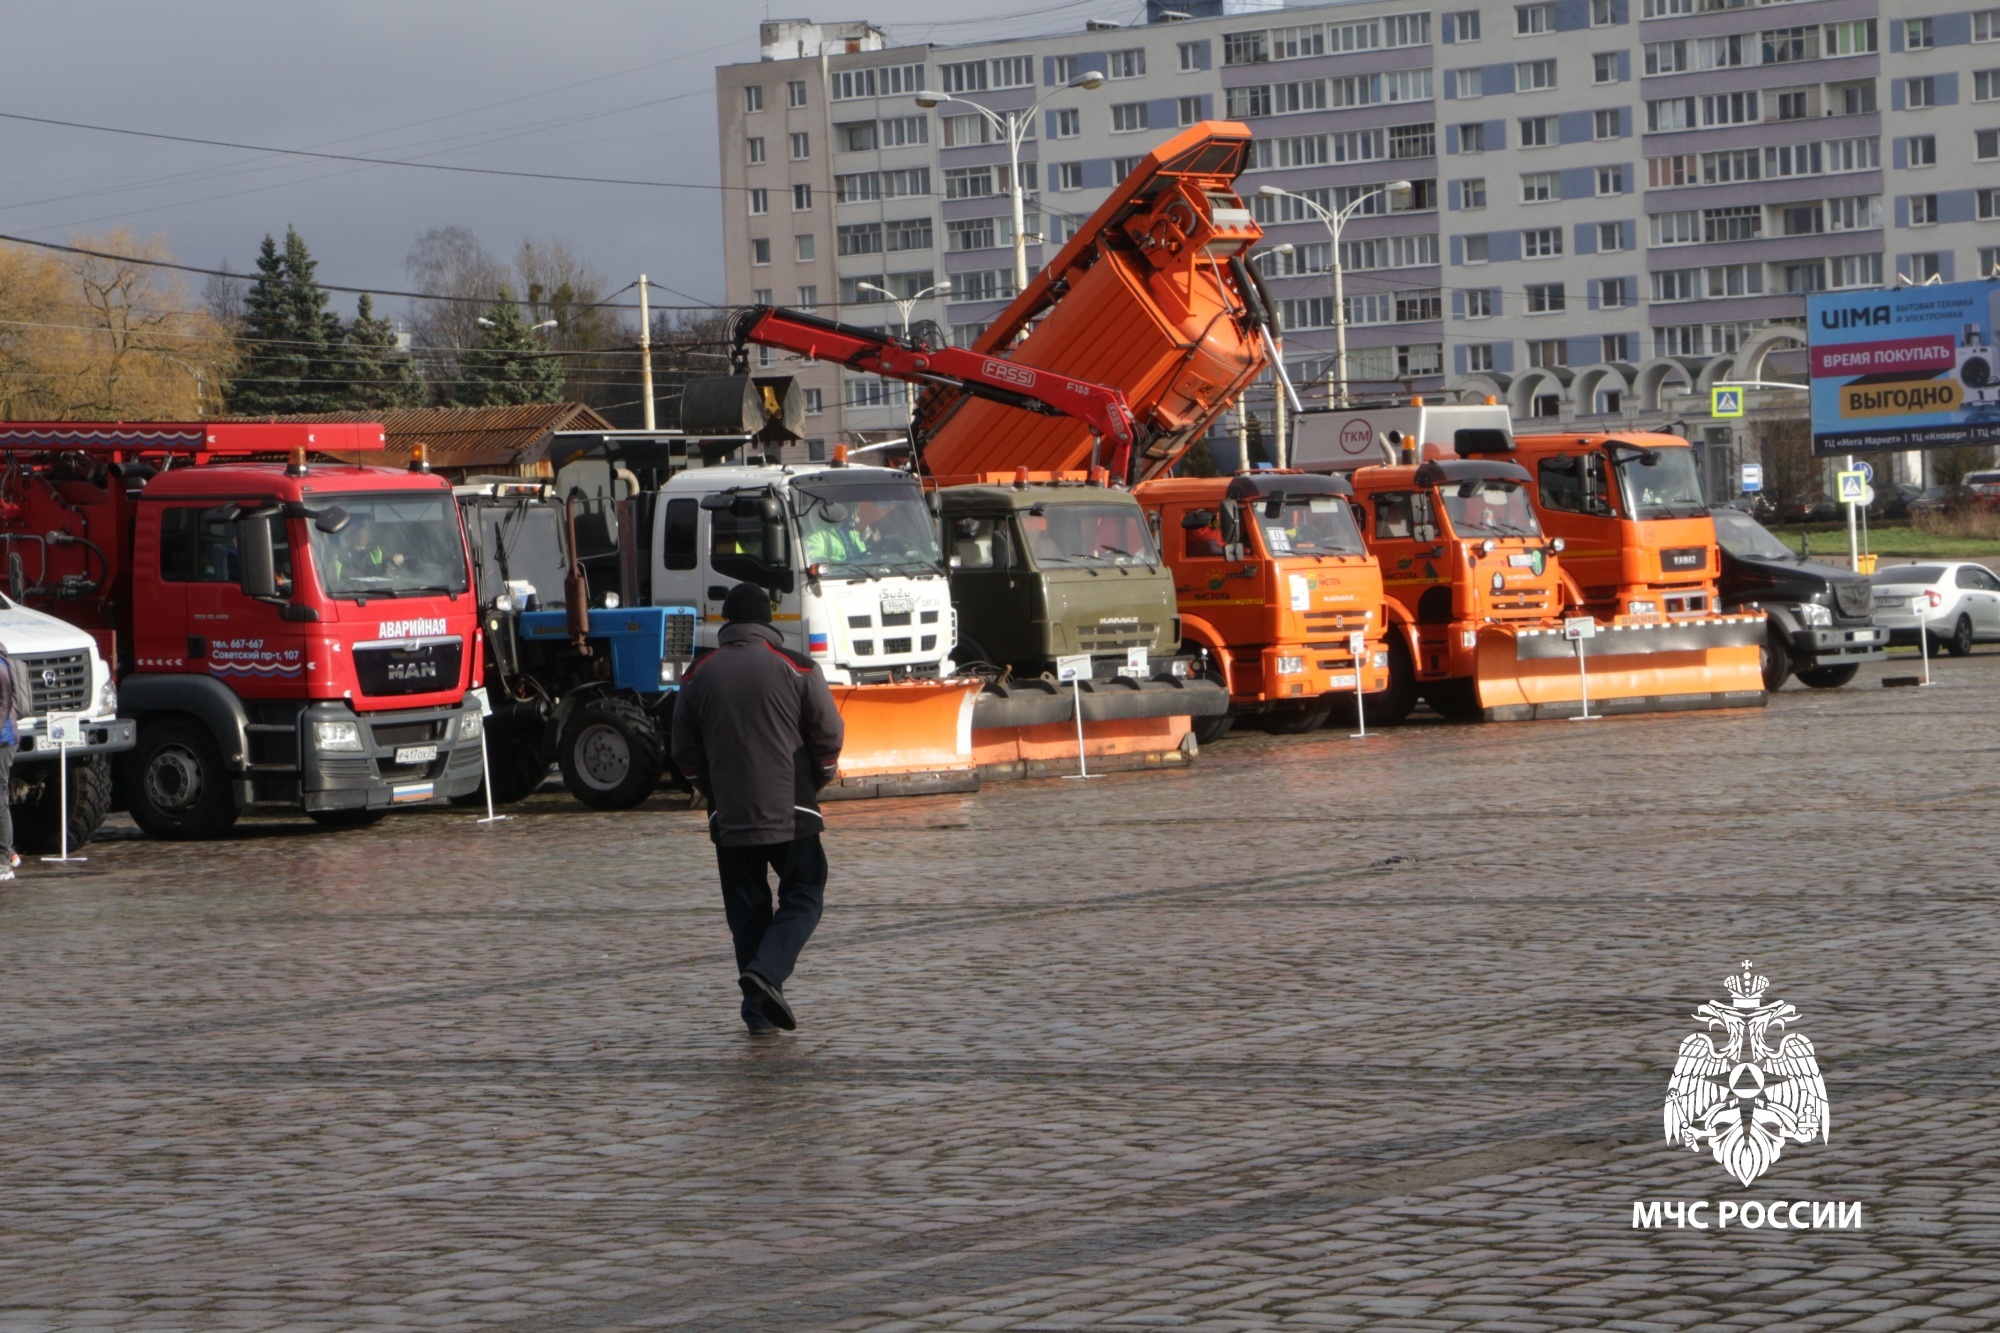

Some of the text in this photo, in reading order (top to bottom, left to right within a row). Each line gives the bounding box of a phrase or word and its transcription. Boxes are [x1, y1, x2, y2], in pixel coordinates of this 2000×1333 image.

[1895, 297, 1975, 313] БЫТОВАЯ ТЕХНИКА
[1904, 310, 1964, 323] ЭЛЕКТРОНИКА
[1823, 345, 1950, 368] ВРЕМЯ ПОКУПАТЬ
[985, 362, 1033, 385] FASSI
[1850, 386, 1954, 411] ВЫГОДНО
[1109, 404, 1123, 432] FASSI
[1823, 439, 1836, 449] ТЦ
[1836, 436, 1863, 447] «Мега
[1864, 433, 1902, 446] Маркет»
[1911, 433, 1923, 443] ТЦ
[1924, 429, 1967, 441] «Кловер»
[1977, 428, 1989, 438] ТЦ
[378, 617, 447, 639] АВАРИЙНАЯ
[212, 639, 264, 649] тел. 667-667
[212, 650, 299, 661] Советский пр-т, 107
[388, 661, 436, 680] MAN
